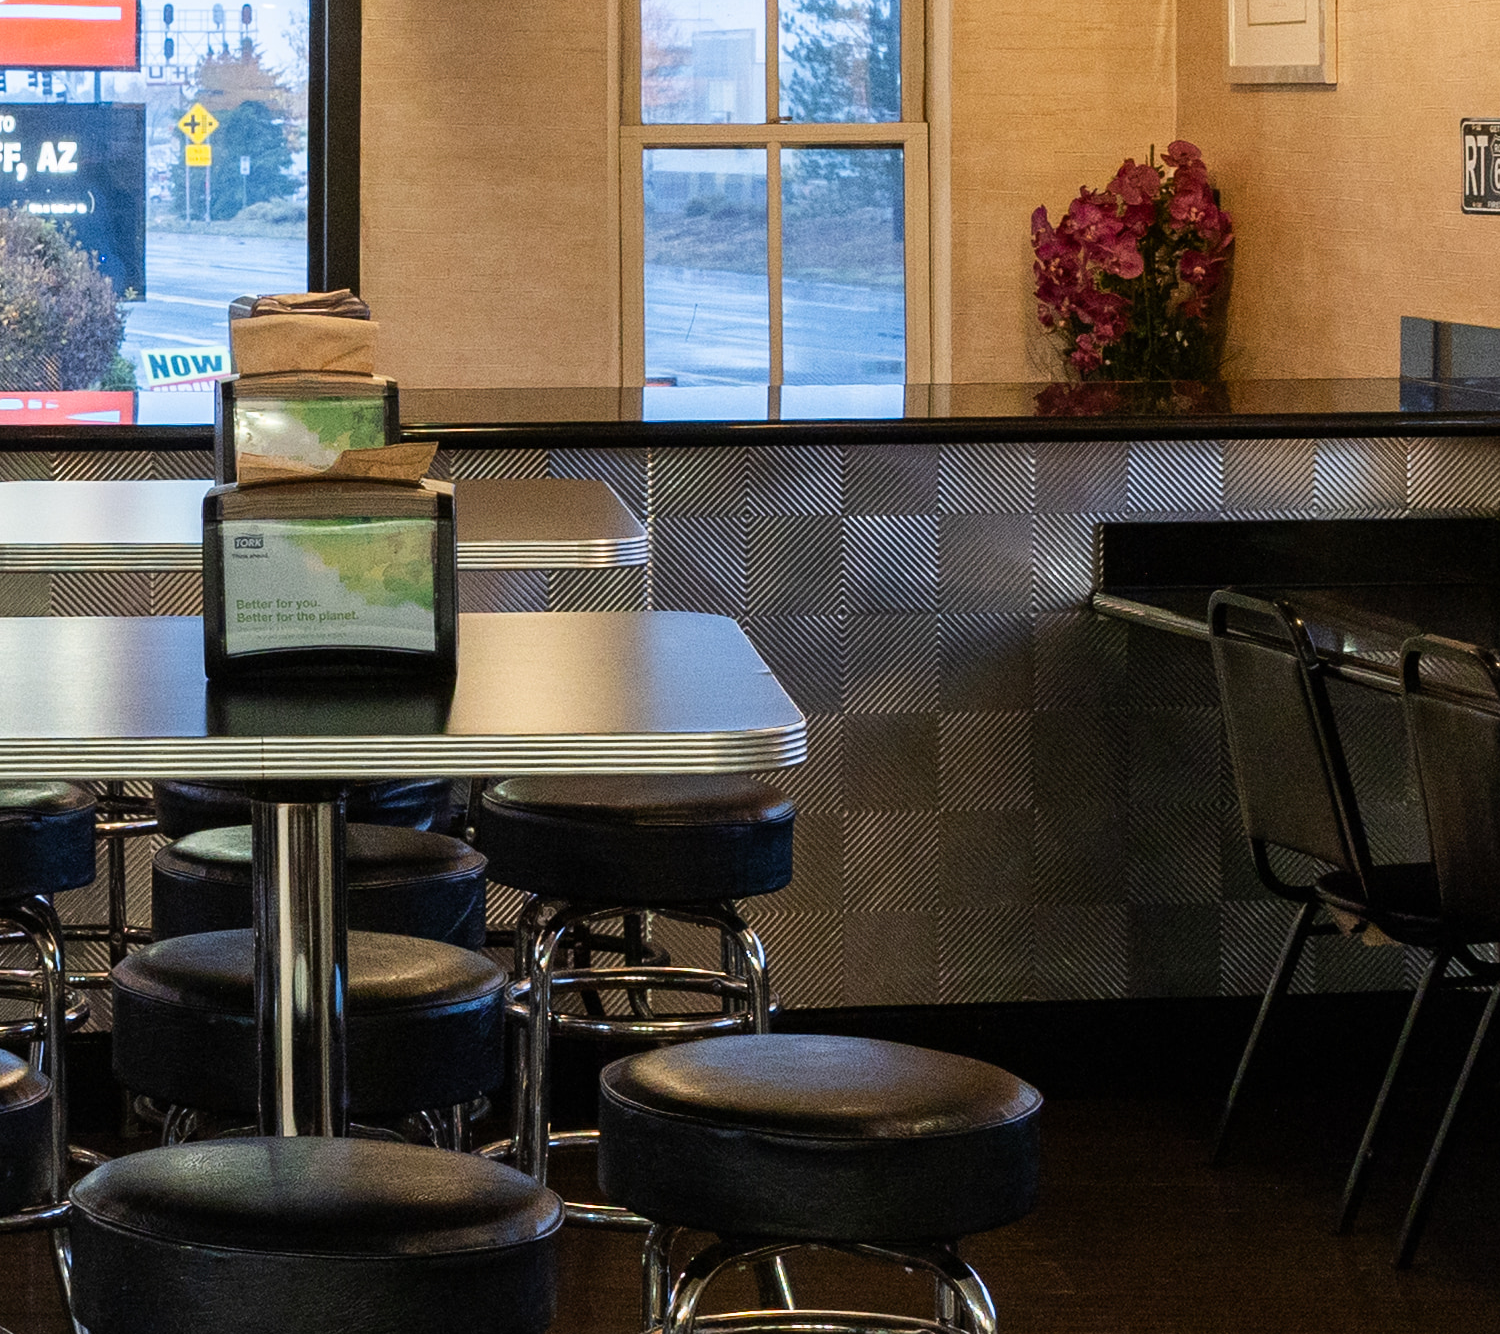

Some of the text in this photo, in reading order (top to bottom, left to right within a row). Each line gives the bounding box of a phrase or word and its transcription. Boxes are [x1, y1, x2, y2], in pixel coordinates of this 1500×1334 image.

[36, 141, 78, 172] AZ
[1464, 135, 1488, 196] RT
[148, 354, 222, 379] NOW
[236, 538, 262, 548] TORK
[236, 598, 320, 610] Better for you.
[237, 610, 359, 623] Better for the planet.
